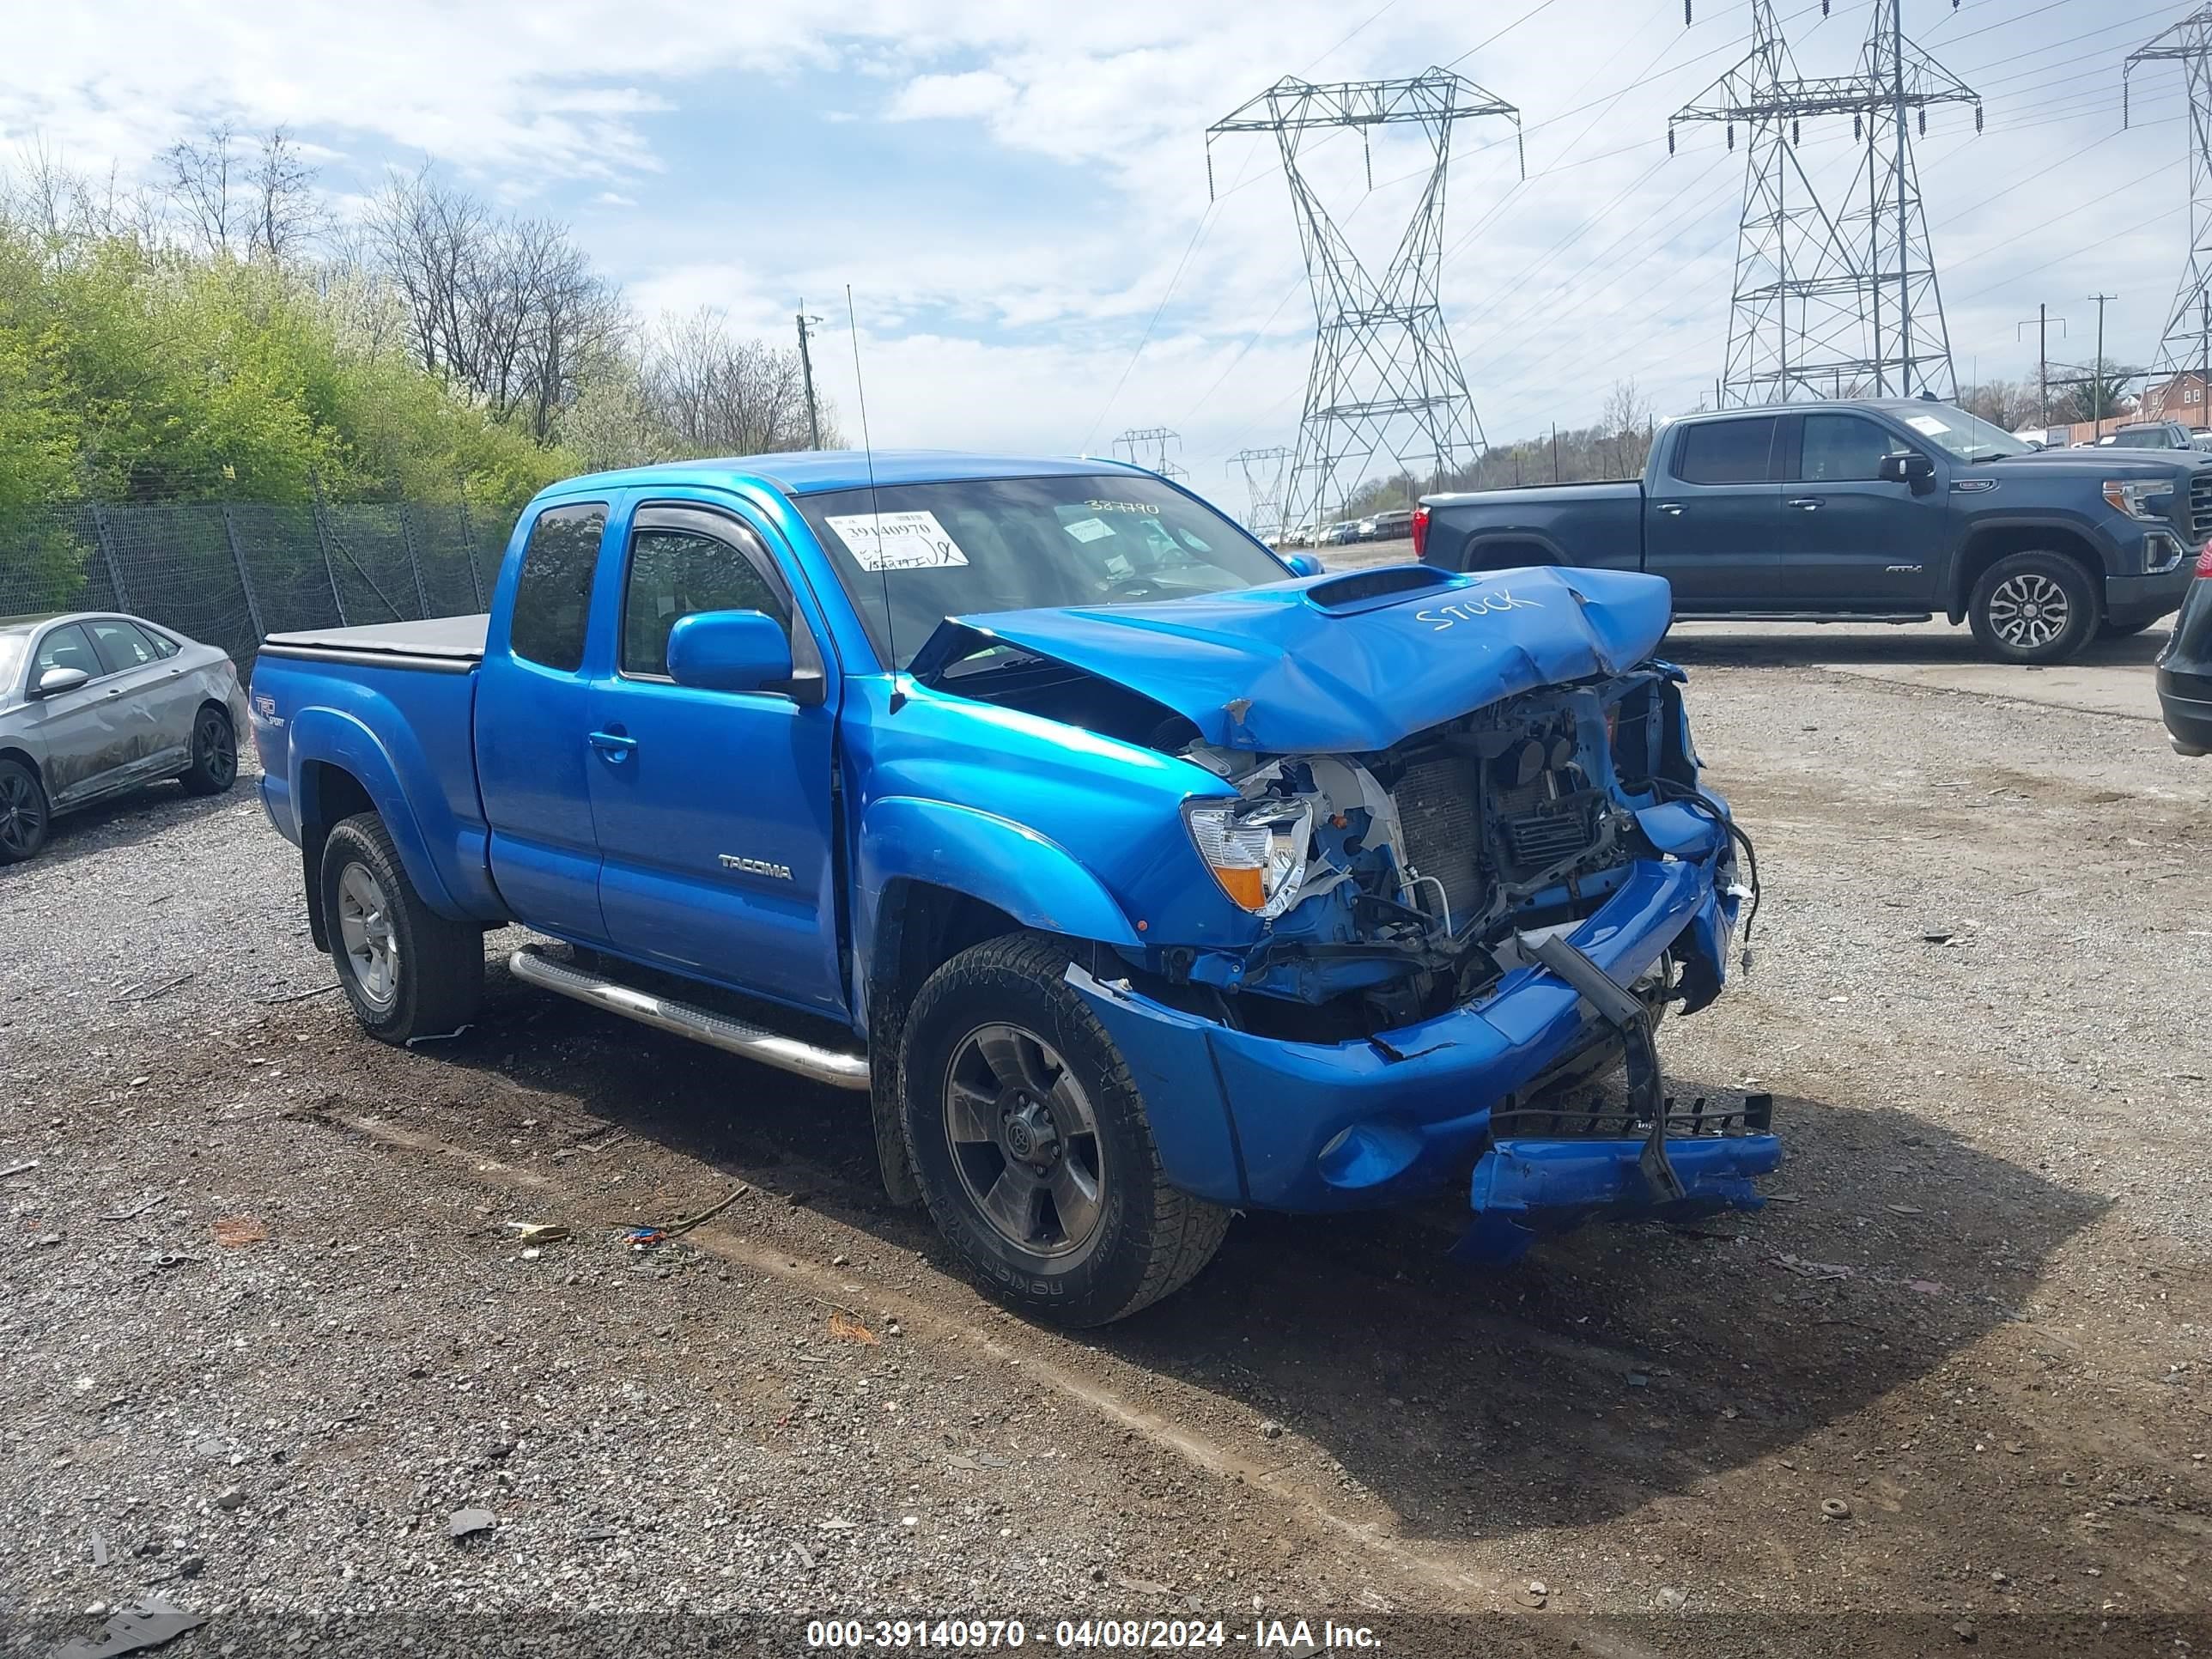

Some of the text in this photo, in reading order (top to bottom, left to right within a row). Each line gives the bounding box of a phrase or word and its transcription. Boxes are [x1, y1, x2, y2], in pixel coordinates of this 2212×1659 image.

[1084, 500, 1159, 514] 387790
[847, 522, 931, 538] 39140970
[1416, 589, 1546, 630] STOCK
[256, 696, 275, 718] TRD
[269, 716, 285, 727] SPORT
[718, 854, 793, 880] TACOMA
